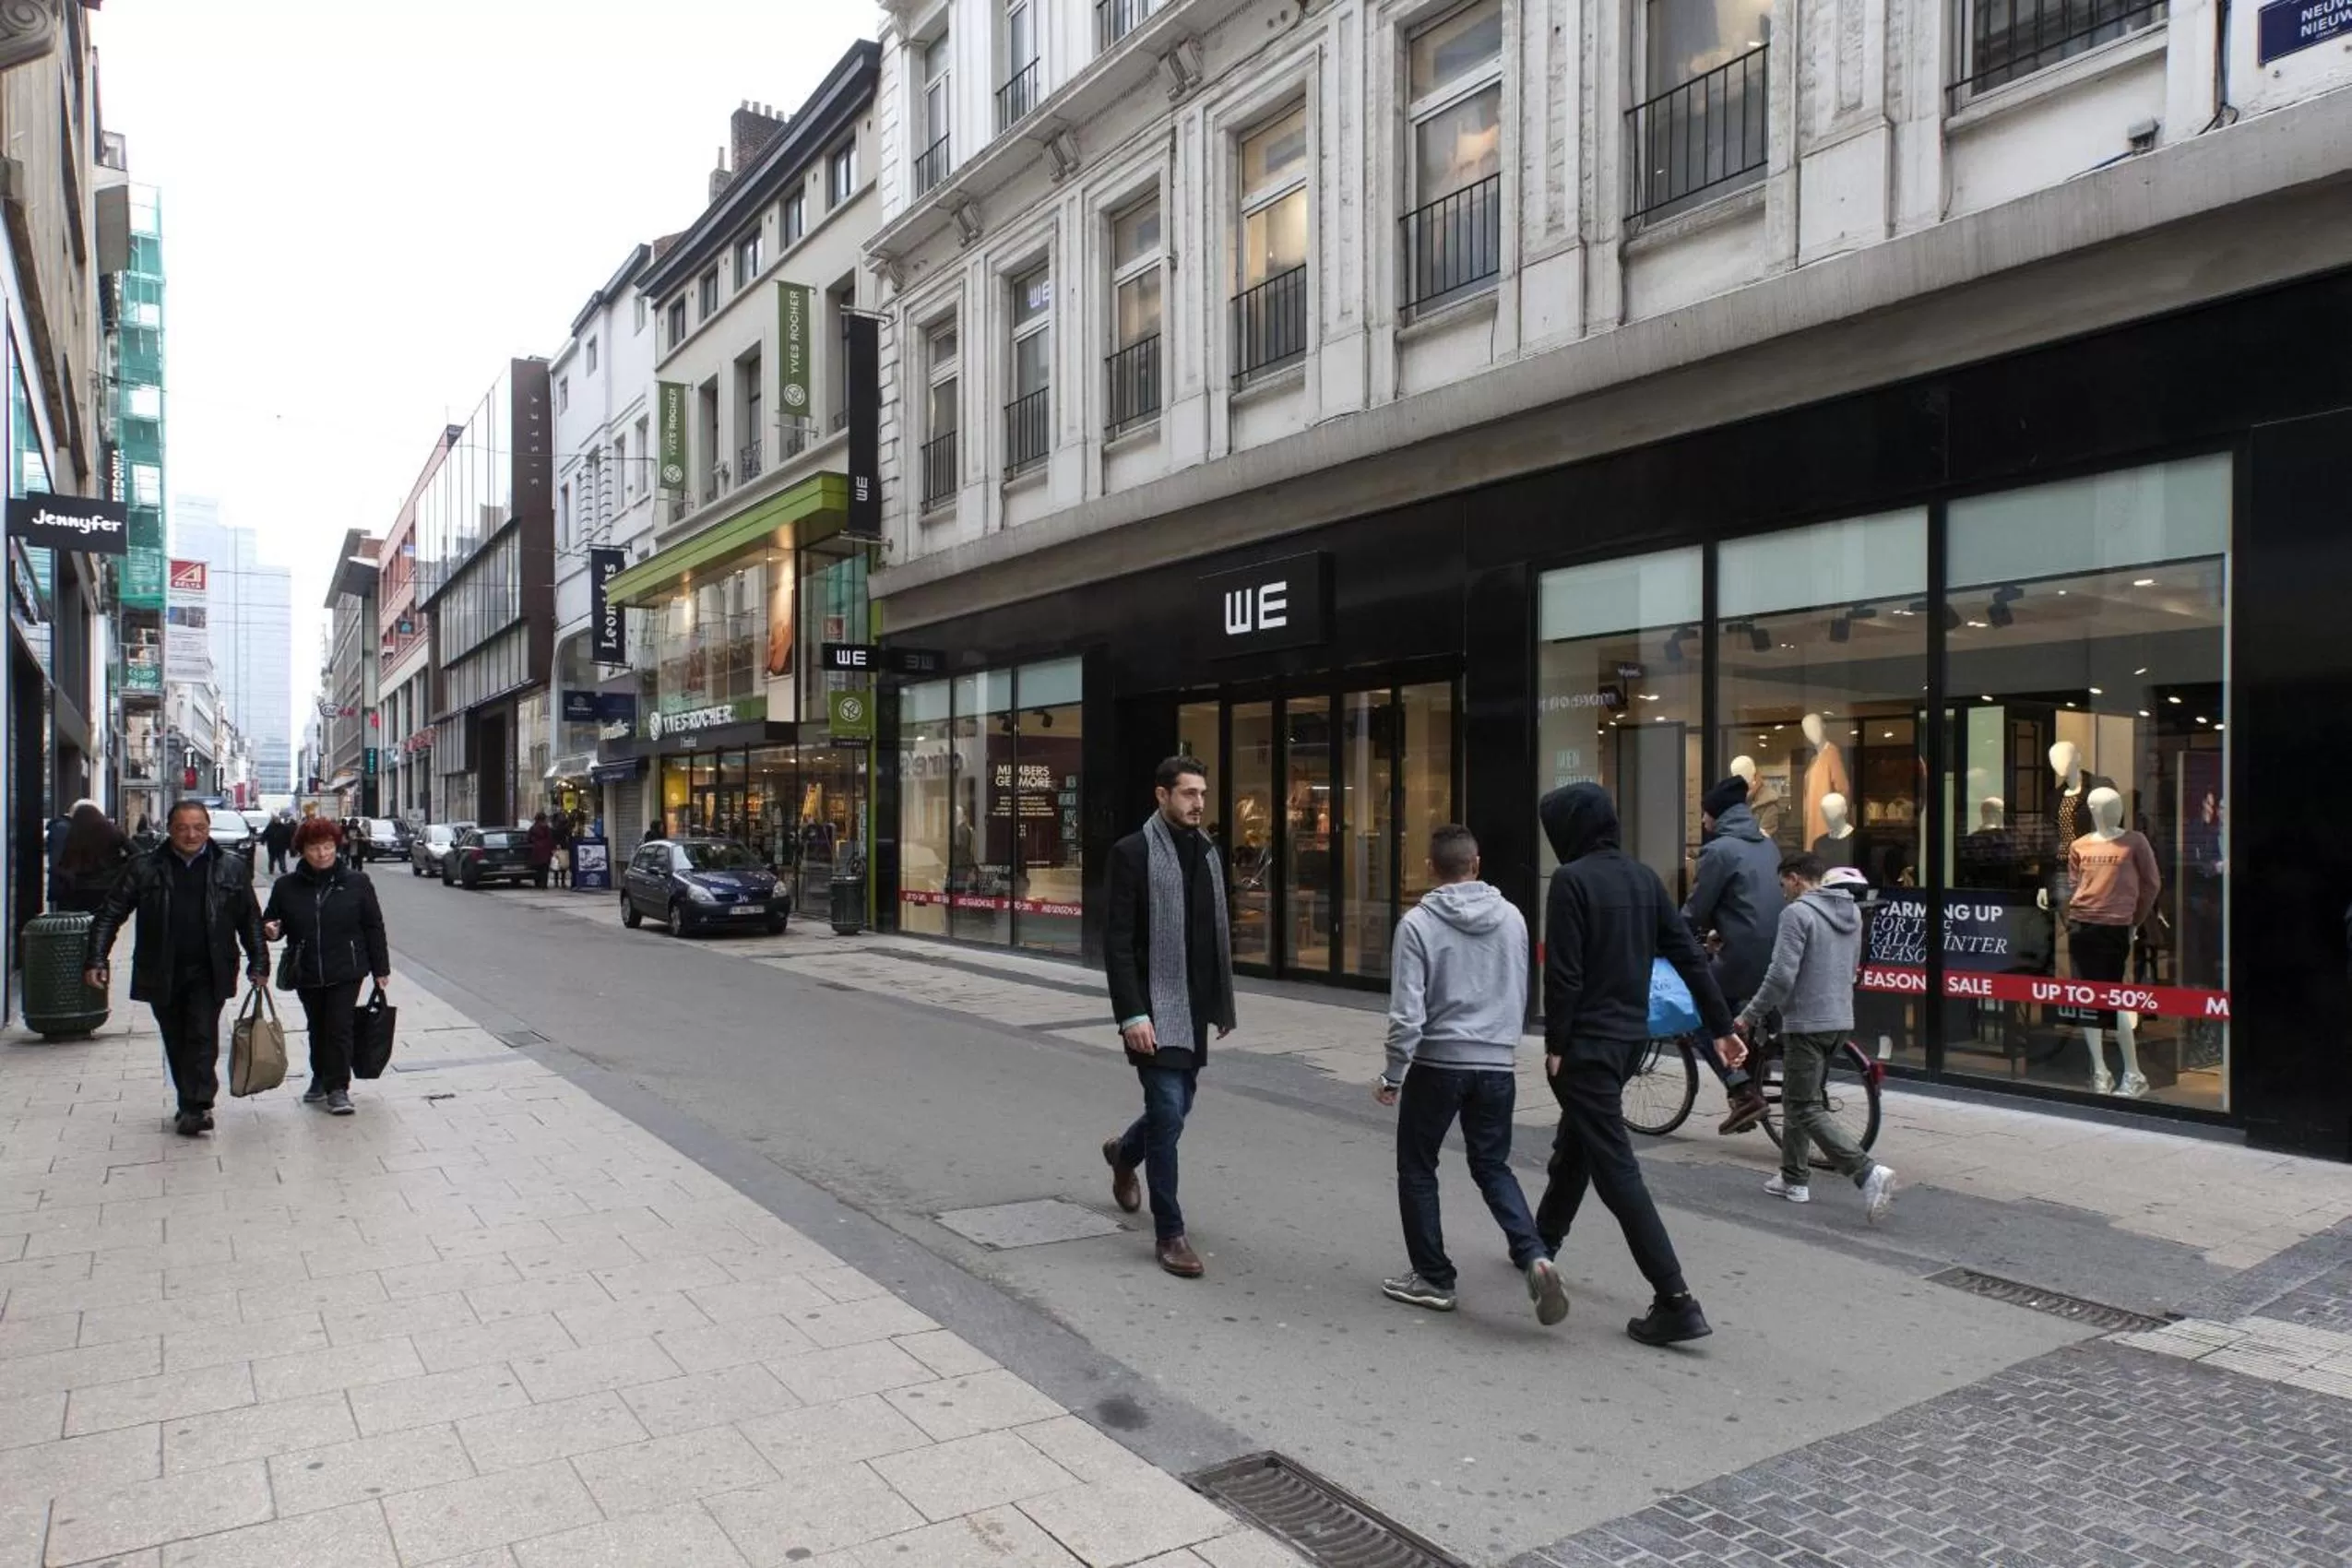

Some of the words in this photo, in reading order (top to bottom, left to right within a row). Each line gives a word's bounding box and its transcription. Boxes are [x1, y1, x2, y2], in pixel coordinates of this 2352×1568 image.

[2301, 0, 2352, 22] NEUV
[790, 291, 800, 341] ROCHER
[790, 344, 800, 374] YVES
[668, 387, 677, 429] ROCHER
[856, 476, 868, 502] WE
[32, 509, 123, 534] Jennyfer
[600, 564, 617, 649] Leons
[1225, 580, 1287, 635] WE
[836, 649, 867, 666] WE
[689, 705, 733, 730] ROCHER
[1018, 778, 1053, 789] MORE
[1880, 900, 1970, 921] ARMNG
[1975, 906, 2003, 922] UP
[1871, 916, 1906, 933] FOR
[1870, 932, 2008, 954] FALL/INTER
[1870, 944, 1927, 963] SEASO
[1948, 976, 1992, 995] SALE
[2032, 982, 2061, 1001] UP
[2065, 985, 2096, 1004] TO
[2099, 989, 2158, 1010] -50%
